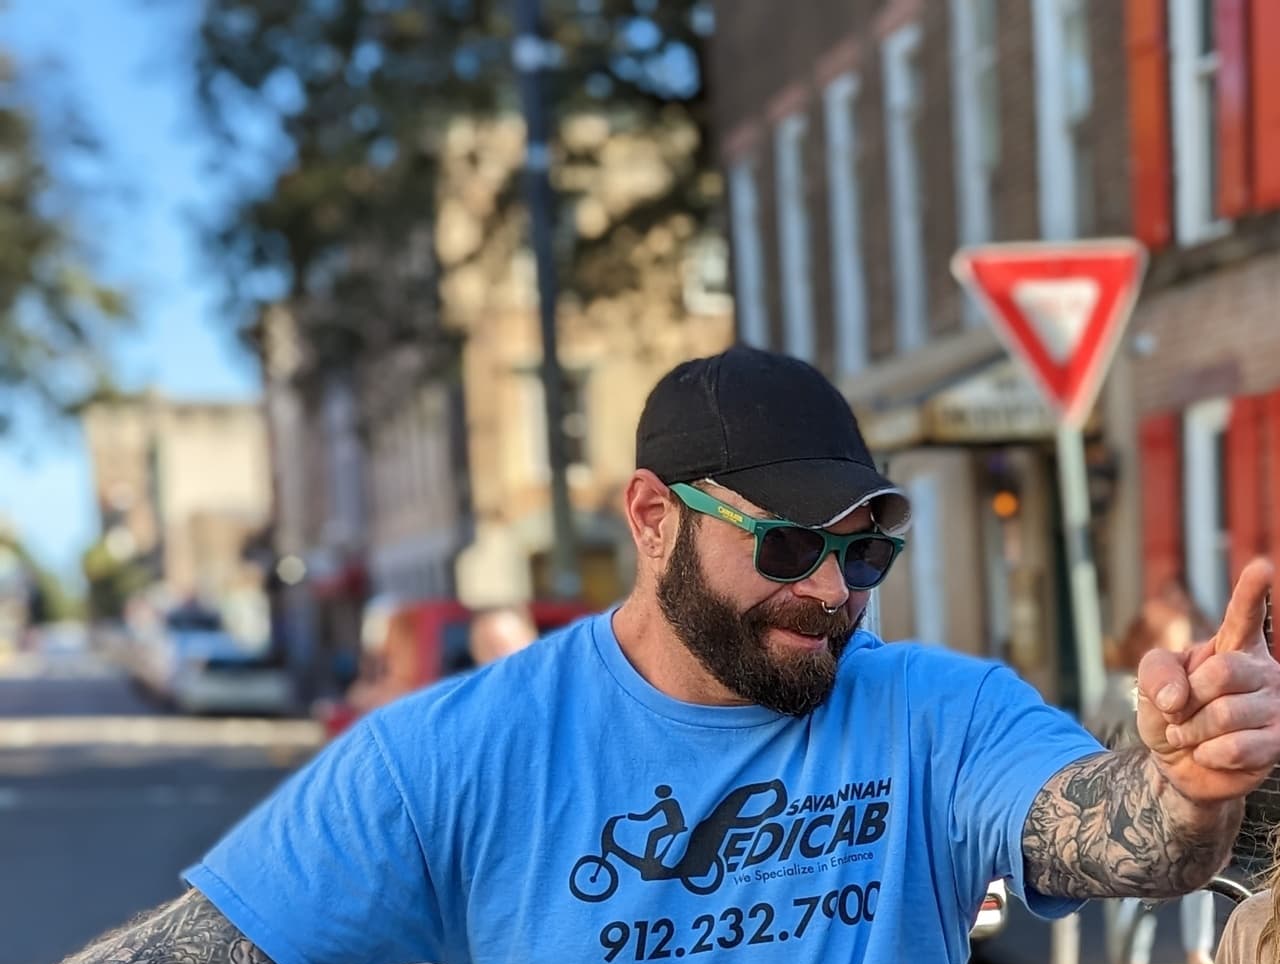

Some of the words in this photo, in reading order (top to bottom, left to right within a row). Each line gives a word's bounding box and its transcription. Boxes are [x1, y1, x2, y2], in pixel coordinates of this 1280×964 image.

[786, 777, 892, 816] SAVANNAH
[755, 863, 815, 884] Specialize
[818, 862, 828, 873] in
